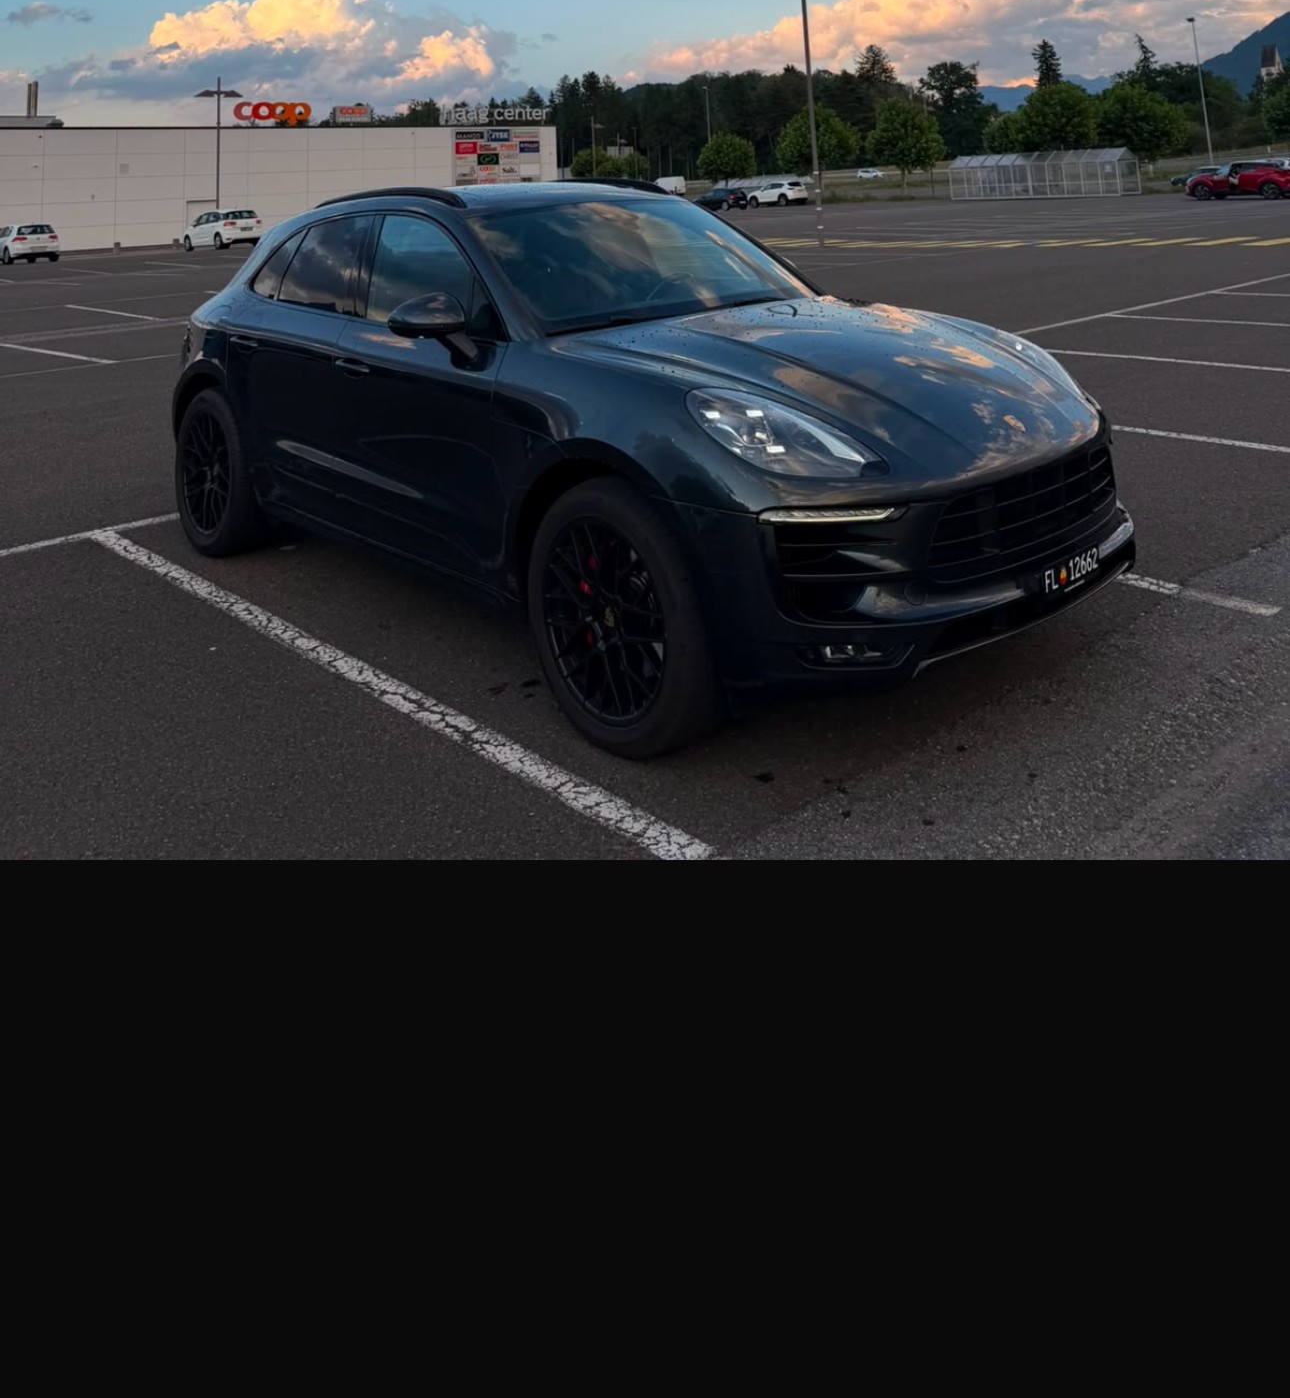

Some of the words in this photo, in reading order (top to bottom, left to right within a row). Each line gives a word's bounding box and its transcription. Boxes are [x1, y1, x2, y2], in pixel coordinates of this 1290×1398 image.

[233, 102, 311, 126] coop
[443, 103, 489, 123] haag
[493, 105, 551, 120] center
[1045, 568, 1059, 593] FL
[1068, 547, 1099, 581] 12662
